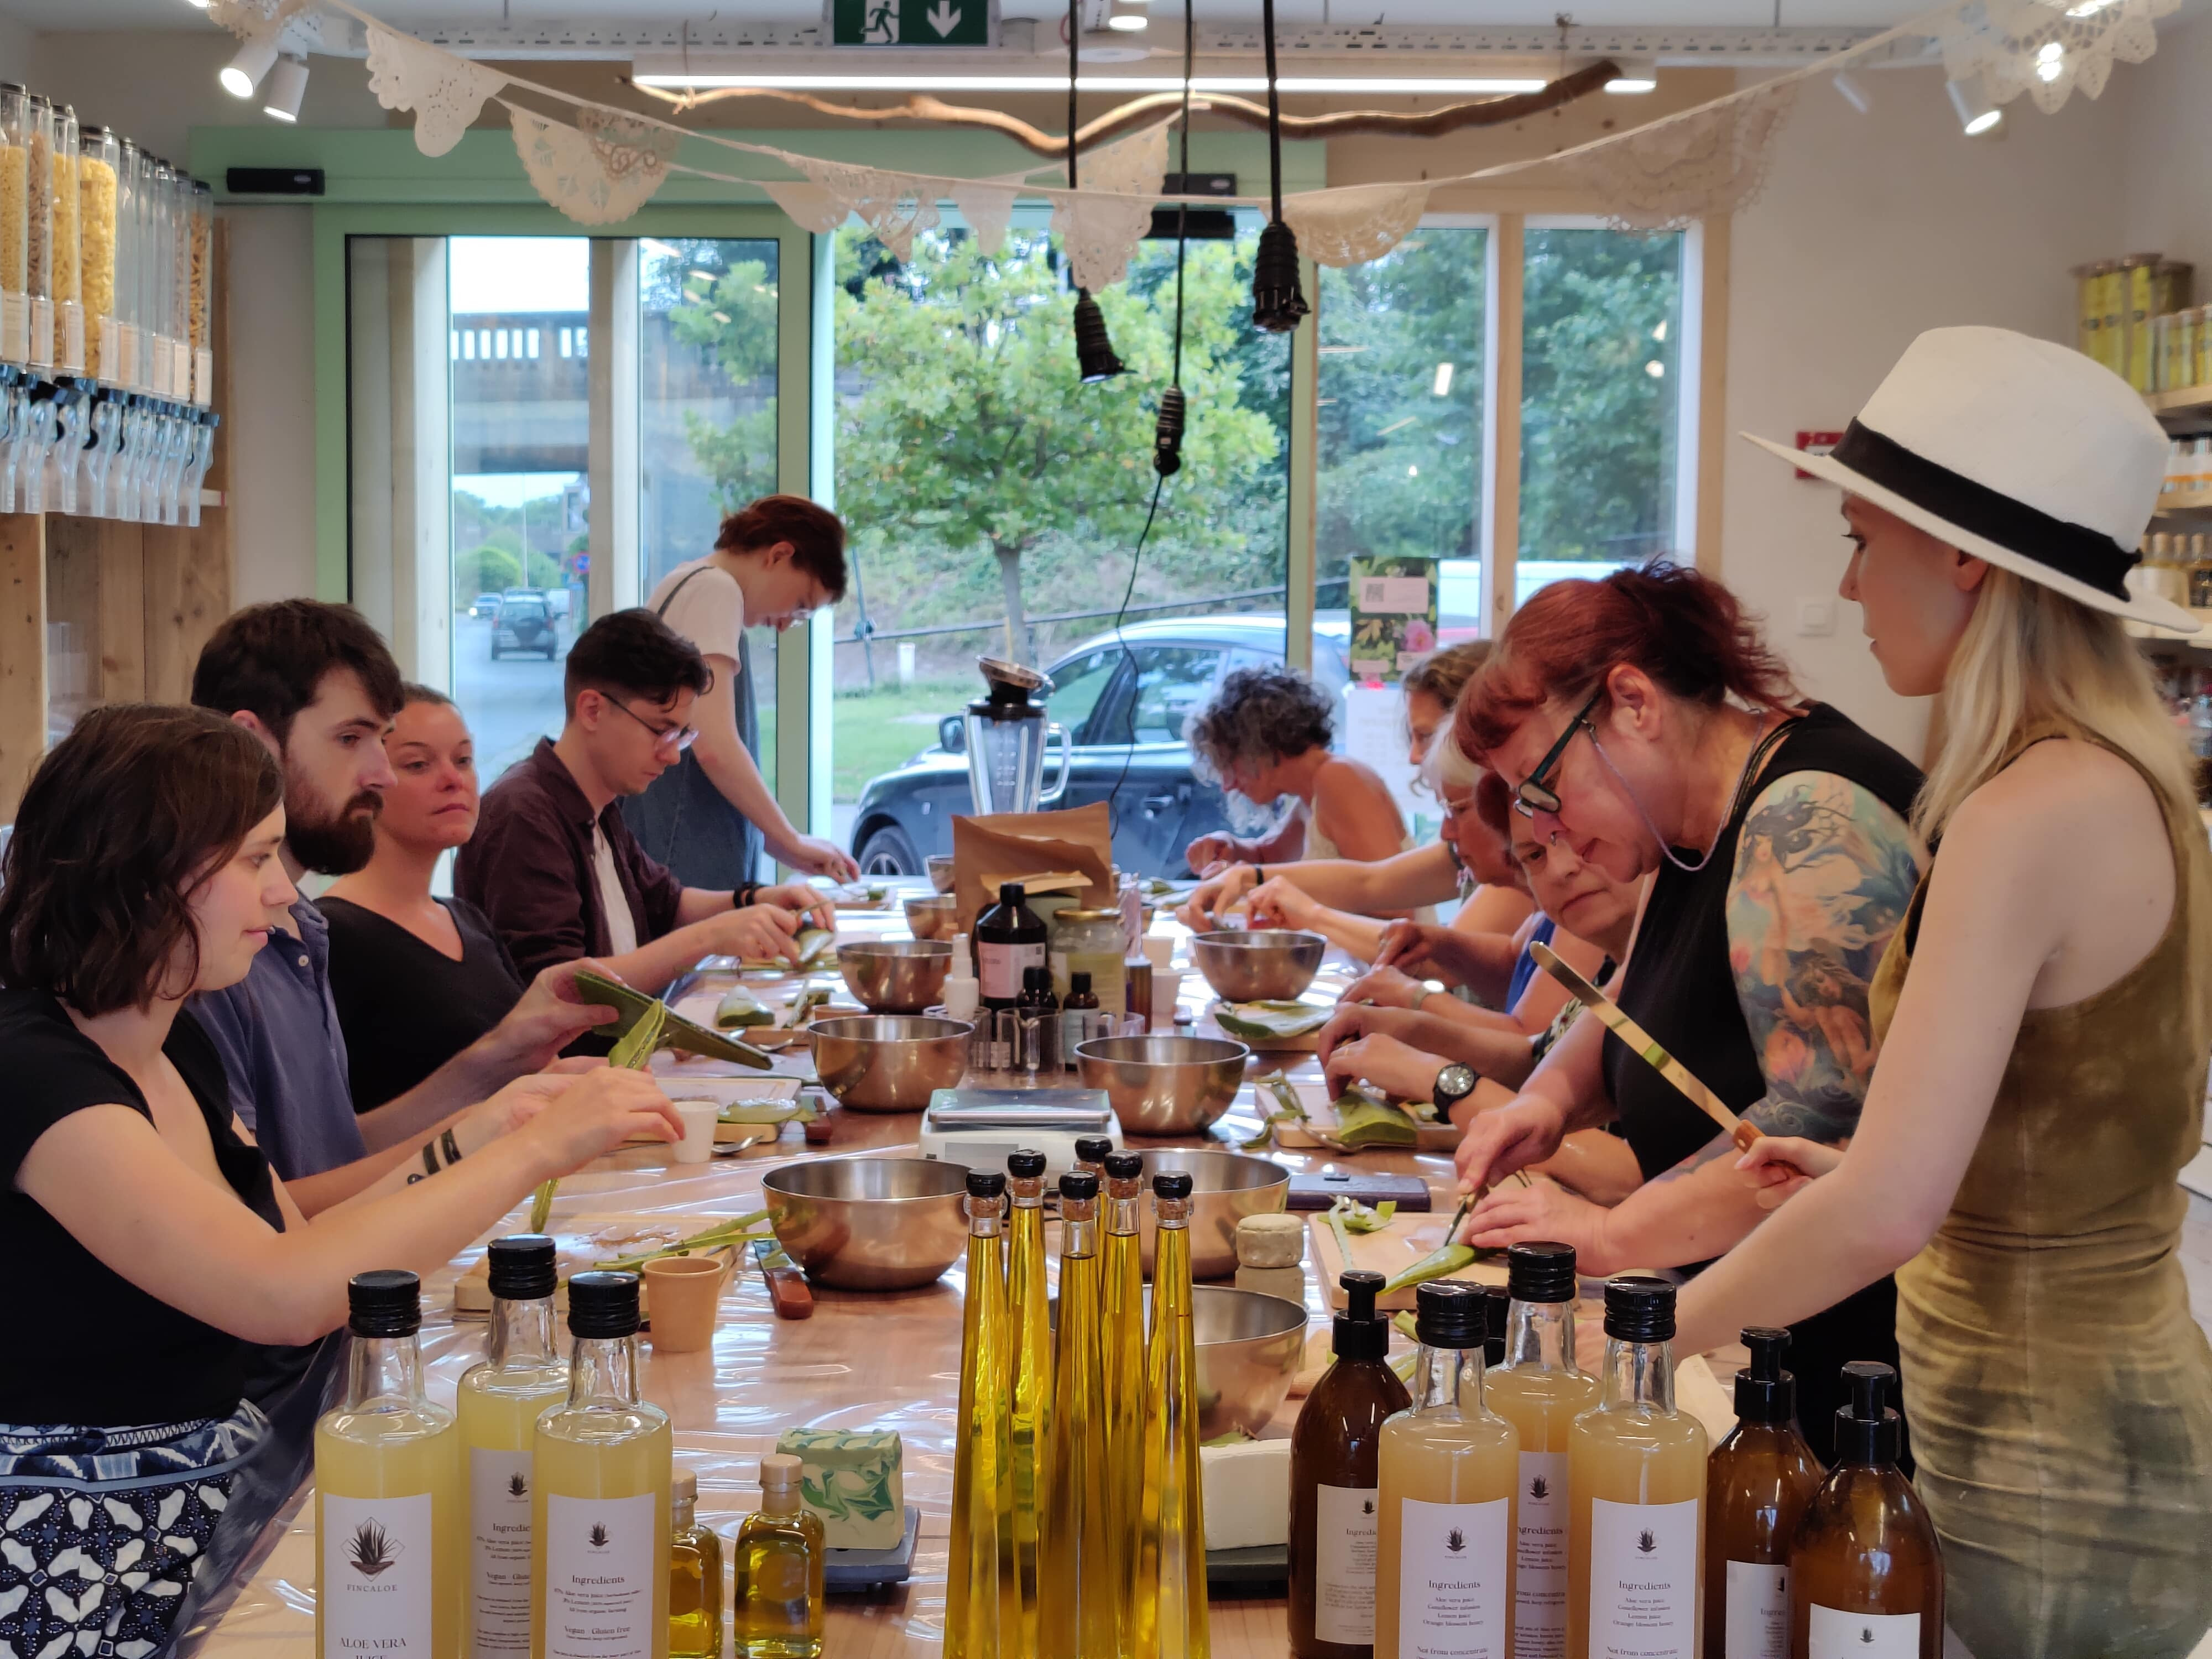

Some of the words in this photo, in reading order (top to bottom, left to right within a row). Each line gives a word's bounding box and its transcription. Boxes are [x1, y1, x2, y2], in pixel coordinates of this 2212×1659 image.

[493, 1523, 531, 1533] Ingredie
[1346, 1528, 1376, 1537] Ingredi
[1517, 1527, 1563, 1535] ngredients
[572, 1575, 625, 1585] Ingredients
[1429, 1580, 1481, 1590] Ingredients
[347, 1584, 398, 1592] FINCALOE
[1619, 1580, 1671, 1592] Ingredients
[340, 1637, 369, 1649] ALOE
[372, 1637, 407, 1649] VERA
[1620, 1648, 1638, 1656] from
